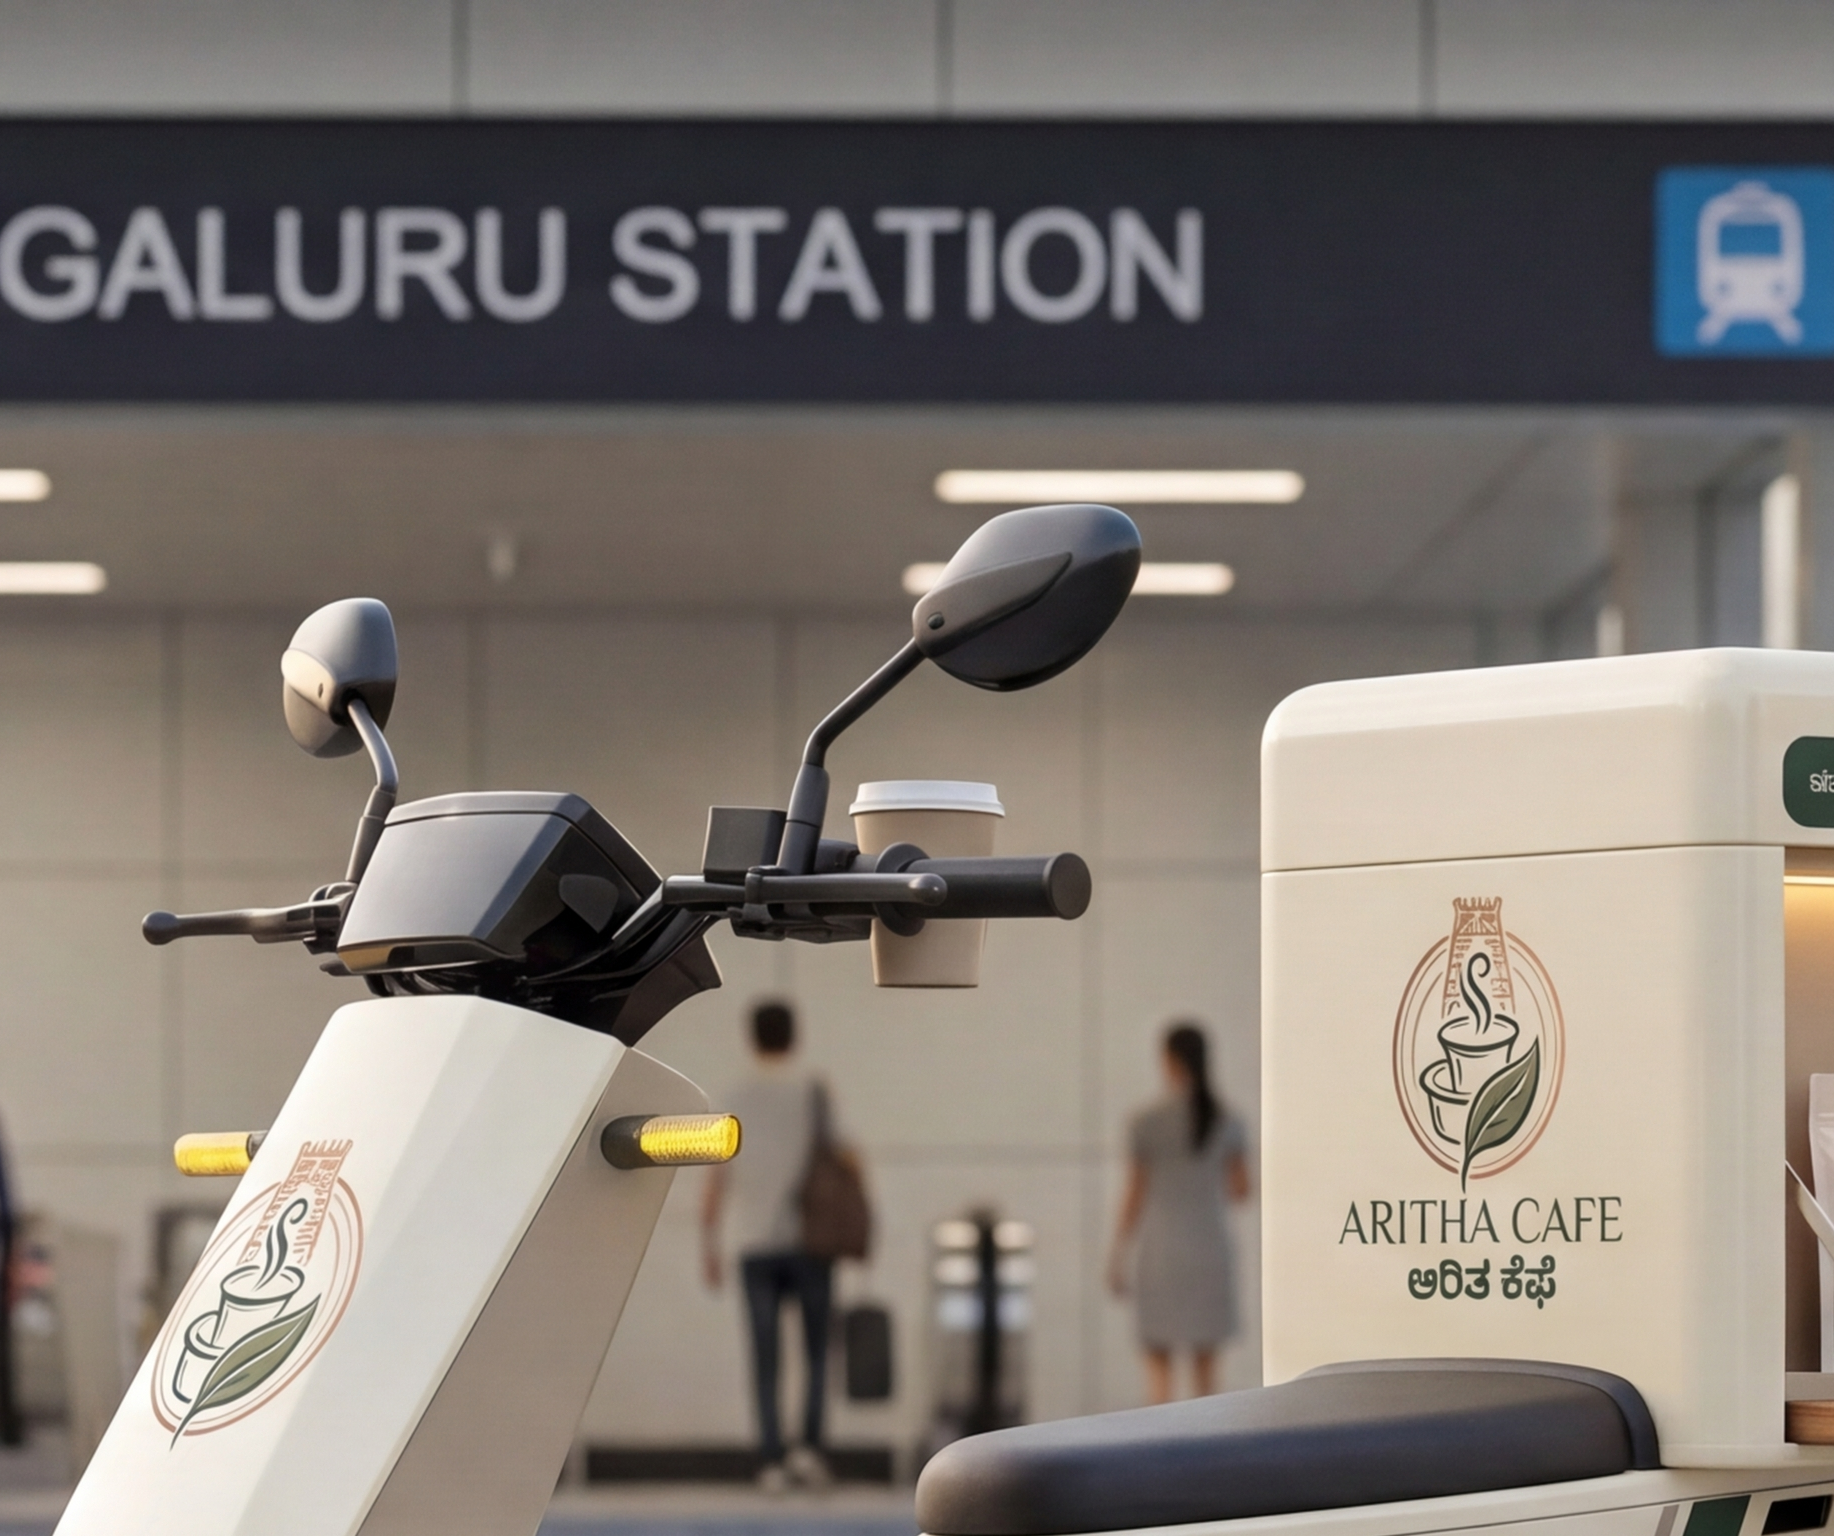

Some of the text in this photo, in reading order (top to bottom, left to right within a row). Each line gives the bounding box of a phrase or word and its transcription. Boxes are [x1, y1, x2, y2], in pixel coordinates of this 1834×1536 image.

[609, 206, 1204, 323] STATION
[1338, 1196, 1624, 1245] ARITHA CAFE
